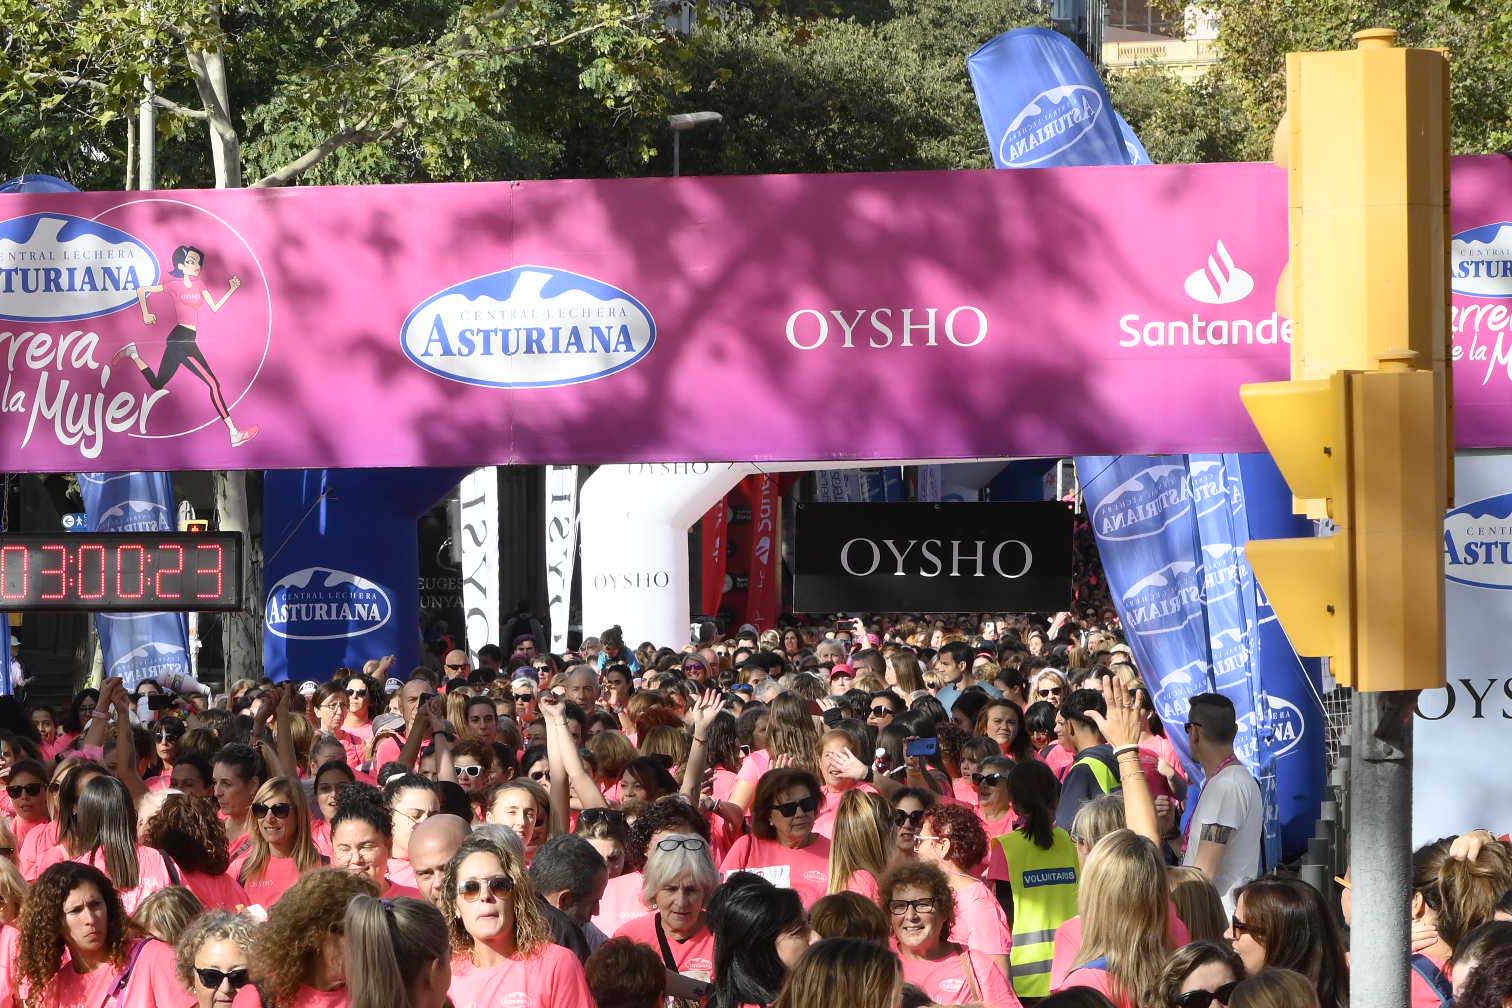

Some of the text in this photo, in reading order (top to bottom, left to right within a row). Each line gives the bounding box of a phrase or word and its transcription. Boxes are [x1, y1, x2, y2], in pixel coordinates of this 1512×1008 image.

[64, 249, 135, 261] LECHERA
[1451, 260, 1512, 278] STUR
[459, 307, 627, 321] CENTRAL LECHERA
[785, 306, 989, 349] OYSHO
[1120, 312, 1295, 348] Santande
[421, 313, 636, 357] ASTURIANA
[1469, 334, 1486, 361] la
[1483, 332, 1512, 386] M
[2, 374, 26, 413] la
[21, 365, 171, 459] Mujer
[1444, 529, 1512, 565] ASTU
[1466, 526, 1512, 536] CENT
[1, 545, 222, 599] 03:00:23
[840, 537, 1034, 579] OYSHO
[268, 594, 381, 625] ASTURIANA
[1415, 678, 1512, 720] OYS
[1023, 871, 1075, 885] VOLUNTARIS
